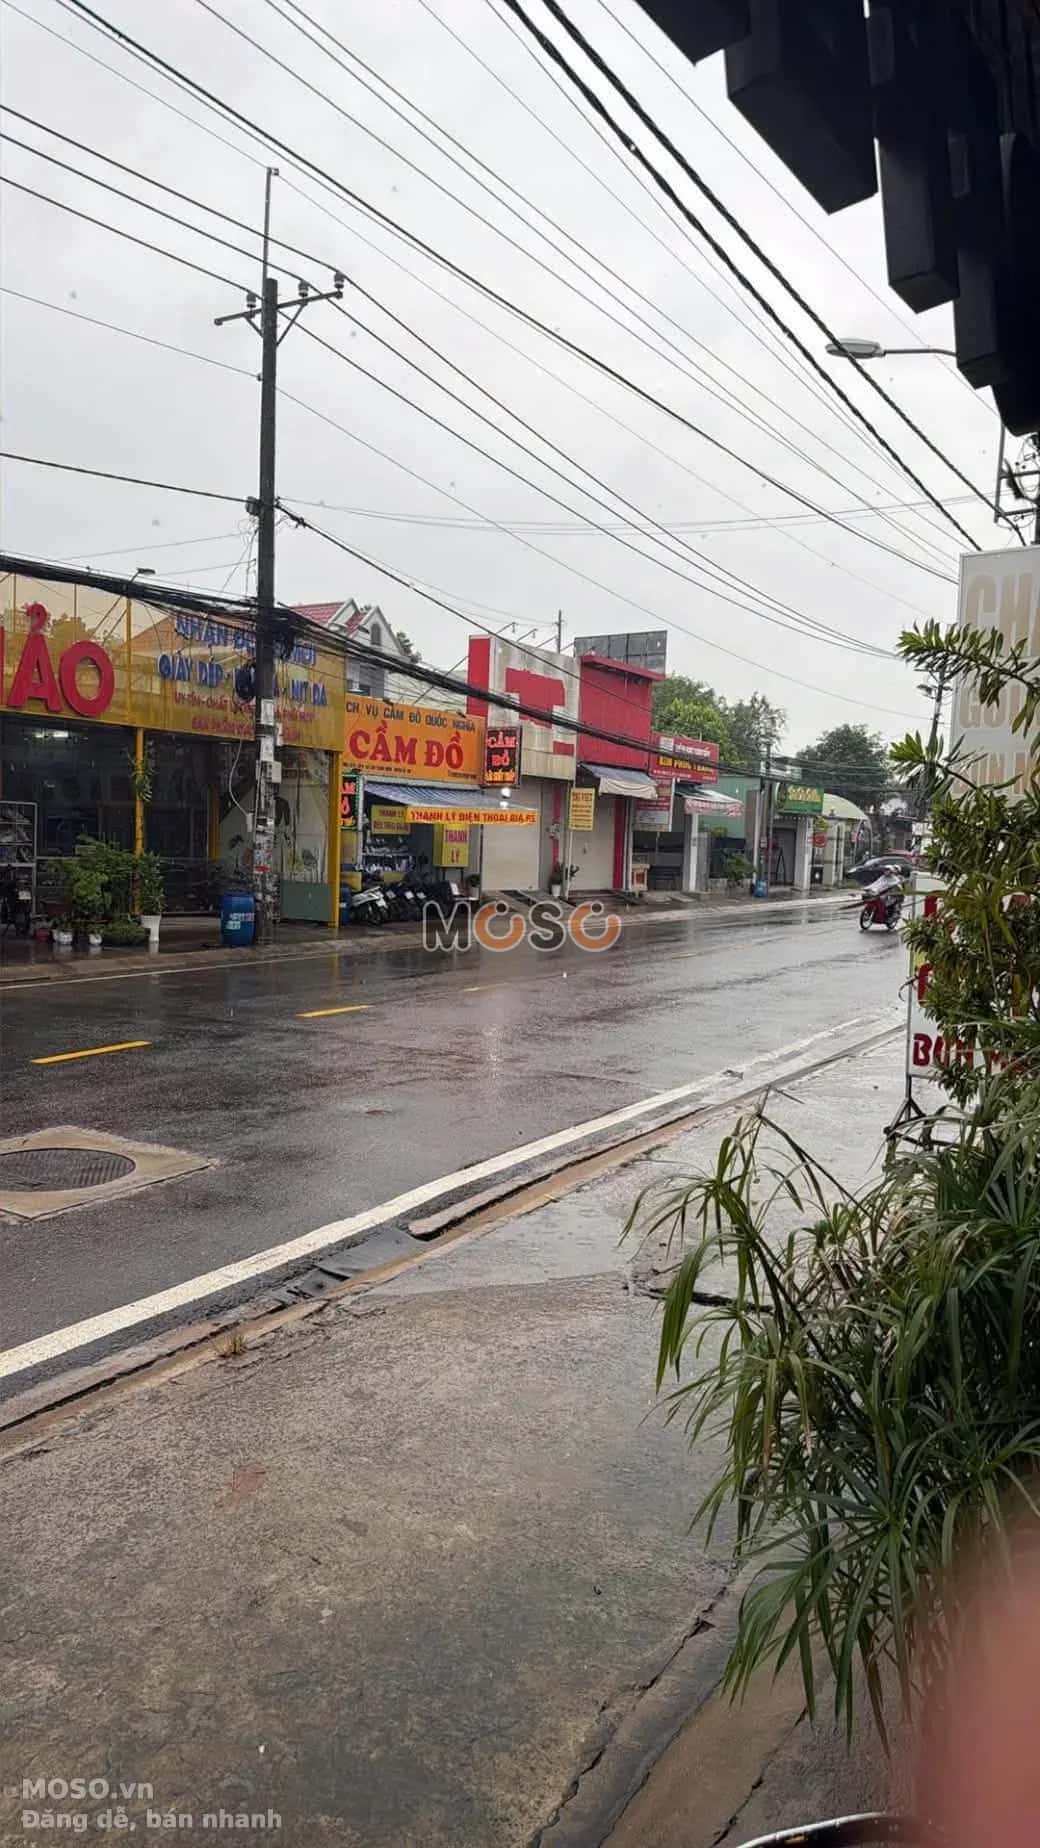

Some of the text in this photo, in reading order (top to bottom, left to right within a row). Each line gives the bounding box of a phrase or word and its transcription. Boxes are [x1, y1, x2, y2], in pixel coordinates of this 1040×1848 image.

[0, 603, 114, 717] ẢO
[349, 720, 464, 769] CẦM ĐỒ
